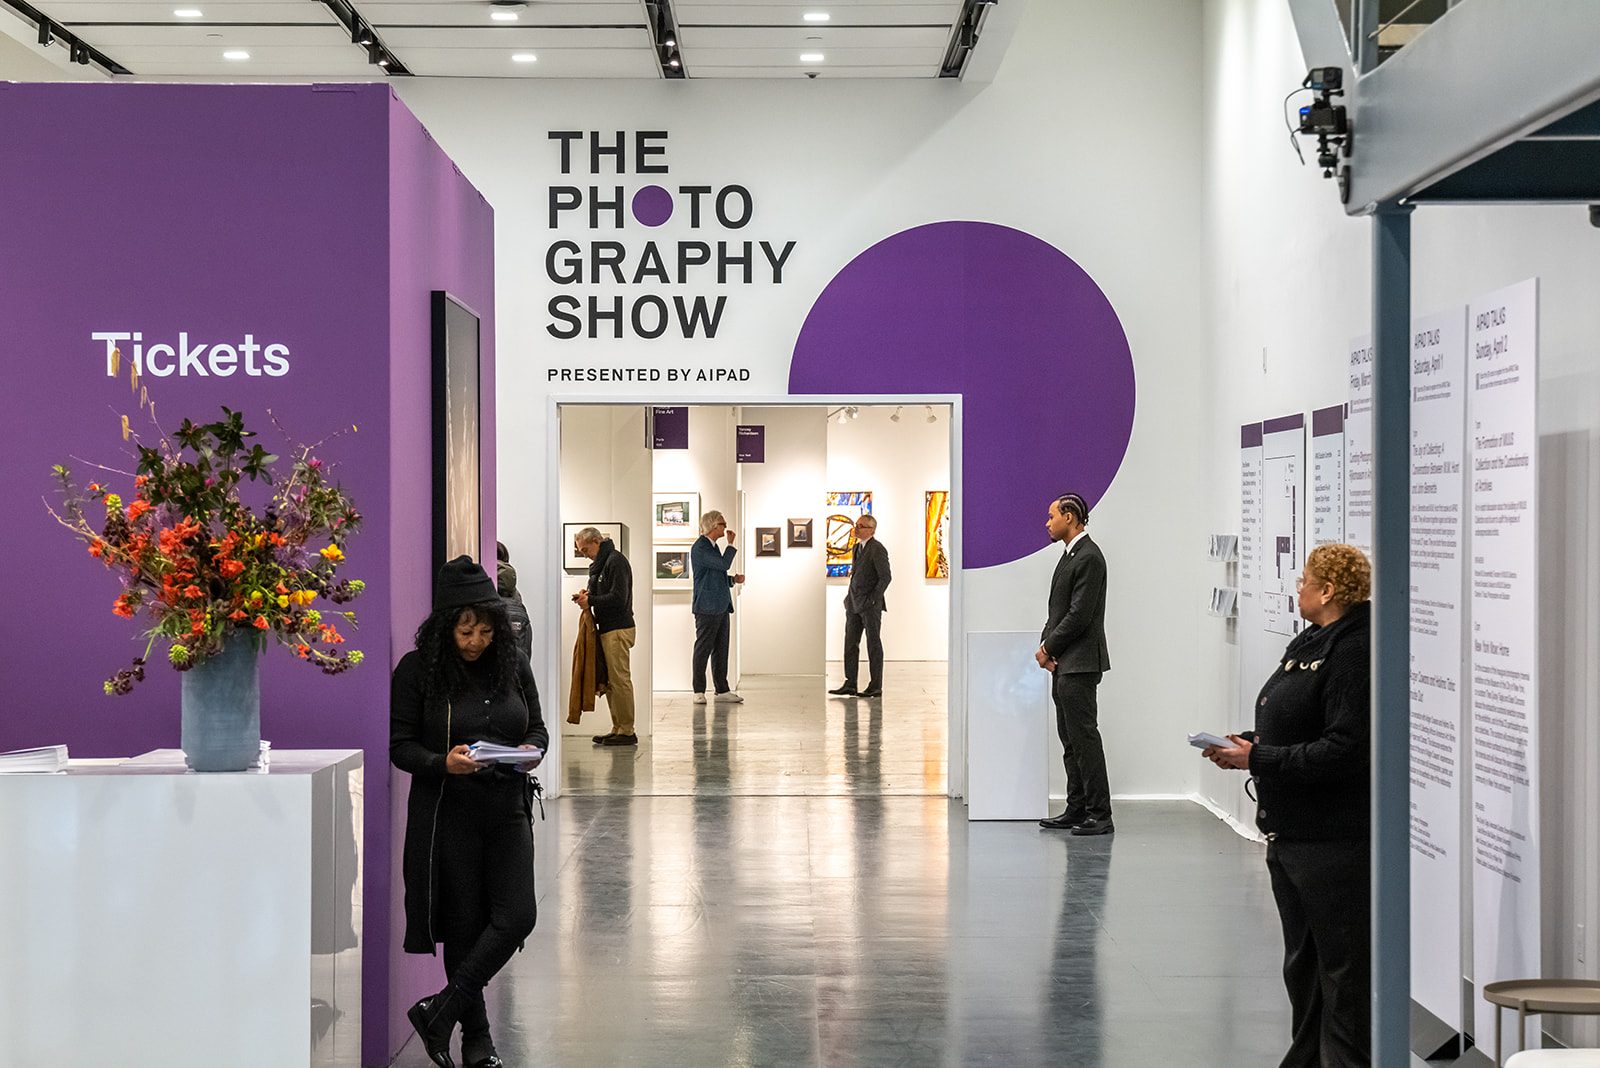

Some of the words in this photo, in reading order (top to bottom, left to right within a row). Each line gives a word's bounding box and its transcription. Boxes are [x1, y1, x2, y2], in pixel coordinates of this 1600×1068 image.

[548, 131, 669, 174] THE
[545, 240, 797, 284] GRAPHY
[546, 295, 727, 339] SHOW
[91, 332, 290, 377] Tickets
[548, 369, 660, 381] PRESENTED
[667, 369, 691, 381] BY
[696, 369, 751, 381] AIPAD
